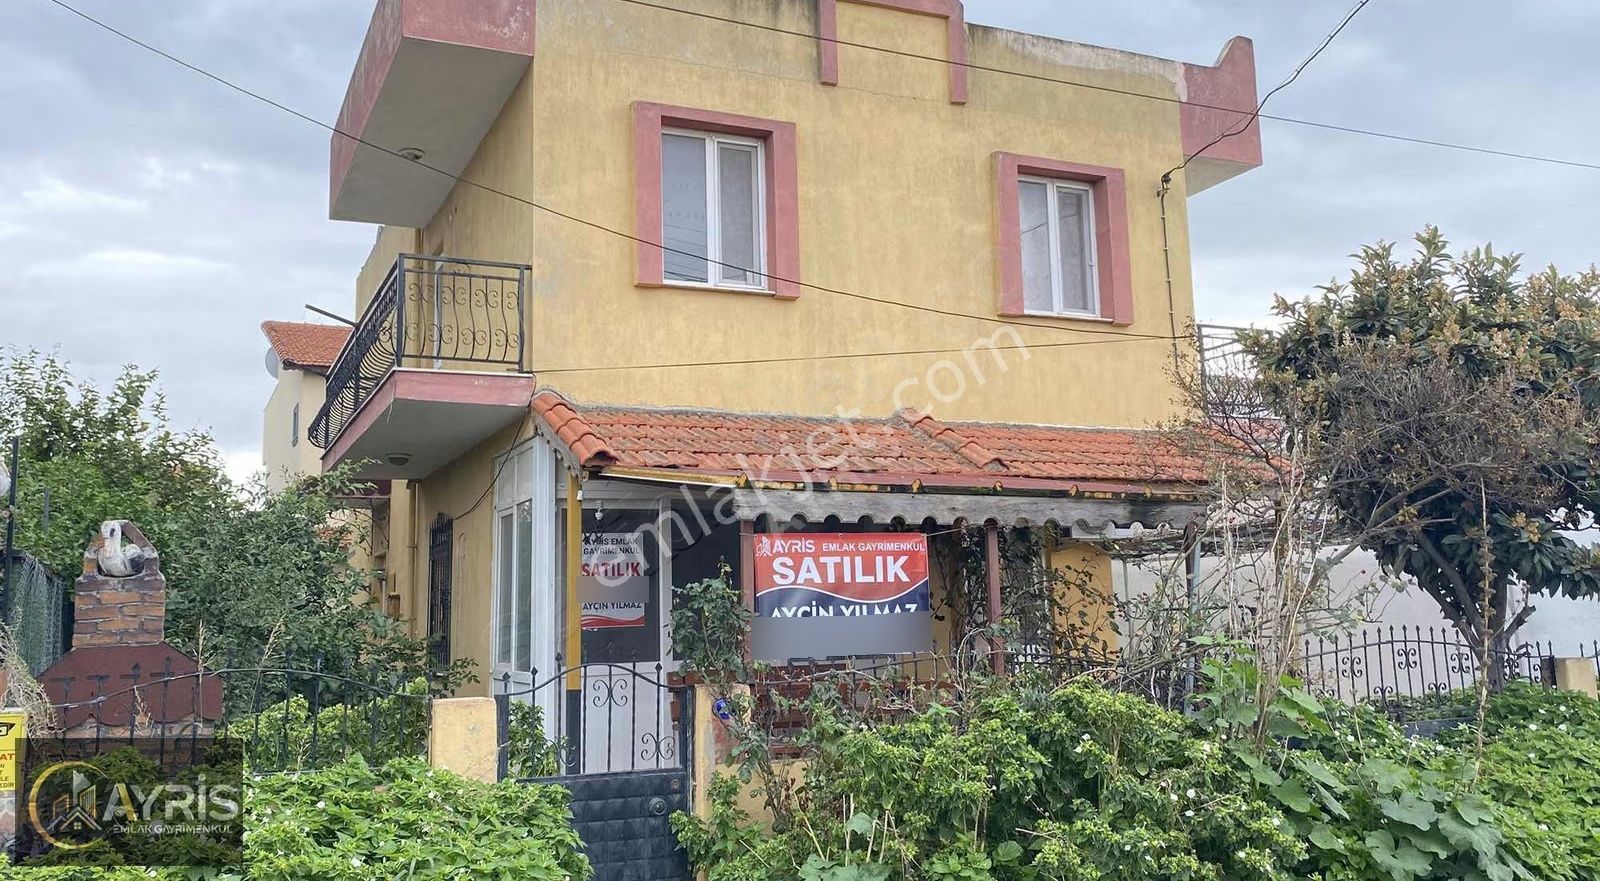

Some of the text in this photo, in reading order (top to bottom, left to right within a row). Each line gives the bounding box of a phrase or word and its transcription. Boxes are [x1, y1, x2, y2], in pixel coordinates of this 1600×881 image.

[822, 542, 856, 551] EMLAK
[858, 540, 925, 551] GAYRİMENKUL
[581, 562, 641, 576] SATILIK
[772, 556, 910, 584] SATILIK
